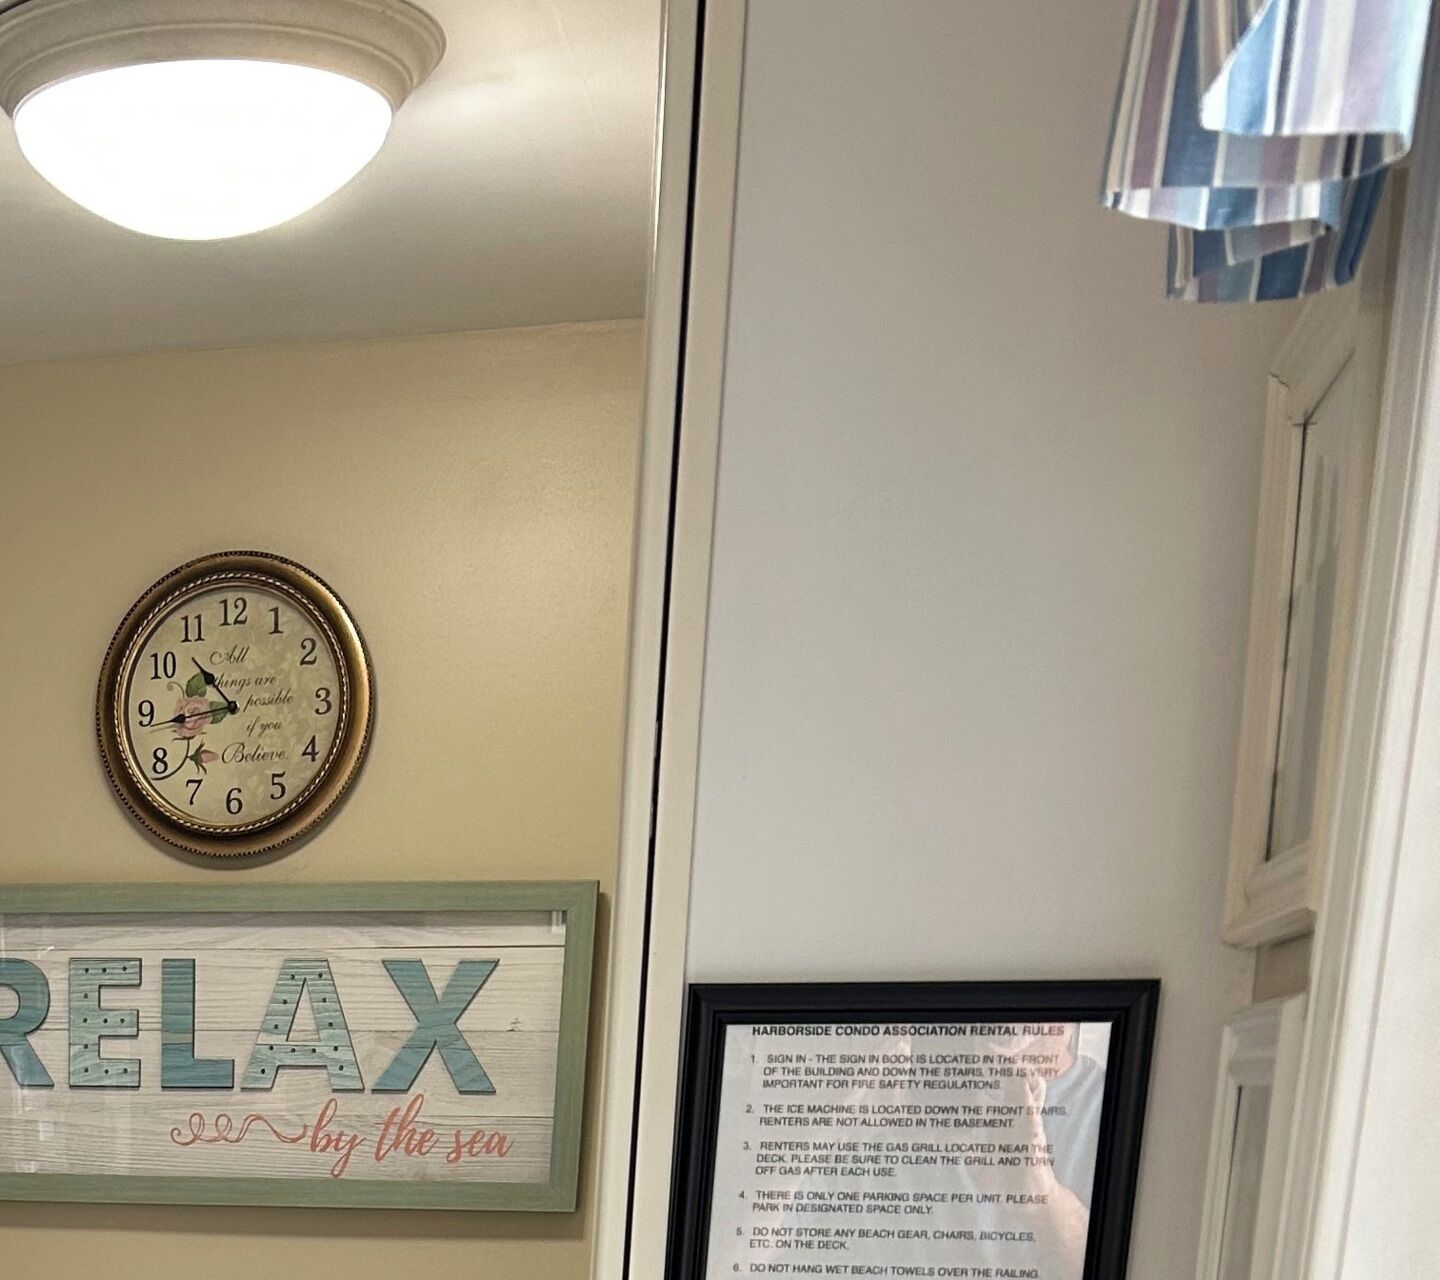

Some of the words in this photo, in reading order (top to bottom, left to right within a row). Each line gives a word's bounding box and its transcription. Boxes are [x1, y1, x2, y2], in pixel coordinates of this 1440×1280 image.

[219, 598, 248, 626] 12
[268, 606, 284, 634] 1
[180, 614, 205, 643] 11
[210, 645, 250, 665] All
[299, 638, 317, 666] 2
[150, 651, 176, 680] 10
[214, 672, 251, 694] things
[255, 675, 276, 685] are
[243, 688, 294, 712] possible
[315, 687, 332, 715] 3
[138, 700, 155, 727] 9
[247, 716, 260, 737] if
[259, 722, 281, 737] you
[152, 747, 168, 774] 8
[301, 735, 319, 762] 4
[186, 779, 203, 805] 7
[270, 772, 287, 800] 5
[226, 788, 243, 814] 6
[752, 1026, 833, 1036] HARBORSIDE
[835, 1026, 880, 1036] CONDO
[883, 1026, 967, 1036] ASSOCIATION
[970, 1026, 1020, 1036] RENTAL
[763, 1079, 824, 1089] IMPORTANT
[826, 1080, 849, 1089] FOR
[852, 1079, 876, 1089] FIRE
[878, 1080, 921, 1089] SAFETY
[308, 1098, 369, 1177] by
[374, 1093, 440, 1161] the
[447, 1125, 514, 1164] sea
[760, 1117, 809, 1126] RENTERS
[812, 1117, 833, 1126] ARE
[836, 1117, 859, 1127] NOT
[860, 1118, 913, 1127] ALLOWED
[916, 1118, 927, 1128] IN
[930, 1118, 952, 1128] THE
[755, 1166, 777, 1175] OFF
[779, 1166, 801, 1175] GAS
[803, 1166, 838, 1176] AFTER
[840, 1167, 870, 1176] EACH
[752, 1202, 780, 1212] PARK
[796, 1203, 863, 1213] DESIGNATED
[866, 1204, 901, 1214] SPACE
[753, 1227, 769, 1236] DO
[771, 1227, 794, 1237] NOT
[796, 1228, 831, 1238] STORE
[834, 1229, 856, 1238] ANY
[858, 1229, 895, 1238] BEACH
[776, 1240, 792, 1249] ON
[794, 1240, 815, 1249] THE
[750, 1263, 766, 1273] DO
[768, 1264, 790, 1273] NOT
[792, 1264, 822, 1274] HANG
[826, 1265, 849, 1274] WET
[851, 1266, 888, 1275] BEACH
[890, 1266, 935, 1276] TOWELS
[938, 1267, 968, 1277] OVER
[971, 1268, 992, 1278] THE
